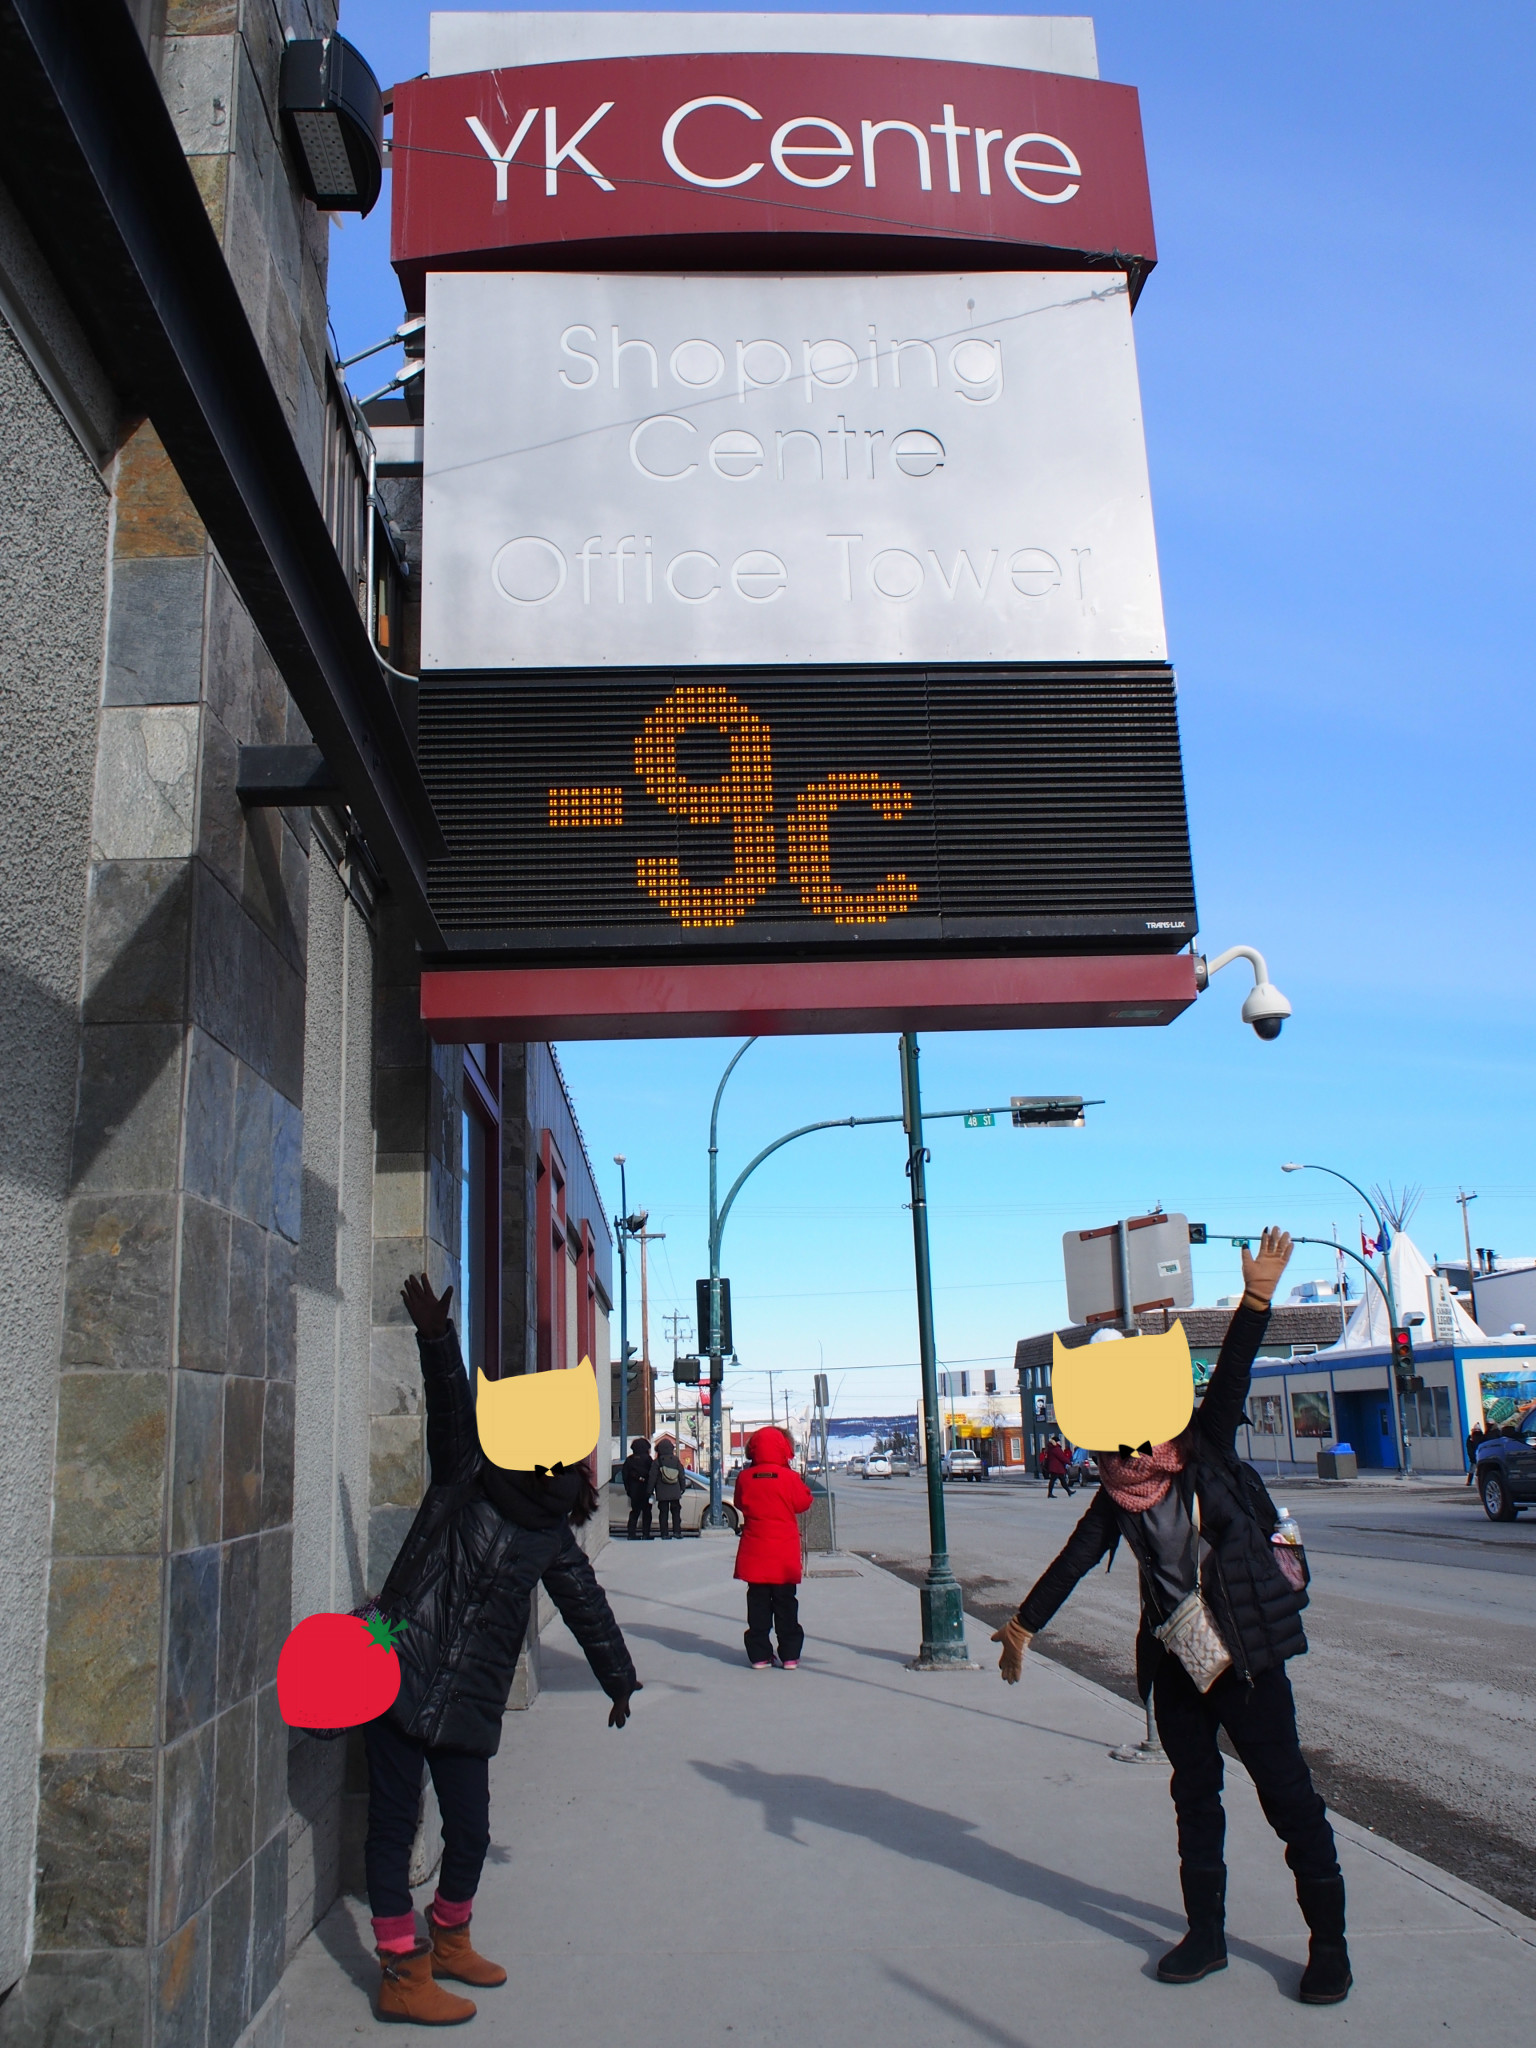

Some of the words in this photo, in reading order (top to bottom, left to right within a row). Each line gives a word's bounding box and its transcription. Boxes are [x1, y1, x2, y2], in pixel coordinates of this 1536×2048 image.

[465, 102, 616, 202] YK
[661, 95, 1083, 204] Centre
[558, 324, 1005, 406] Shopping
[629, 414, 946, 482] Centre
[490, 535, 788, 607] Office
[825, 533, 1092, 603] Tower
[968, 1116, 977, 1127] 48
[983, 1115, 992, 1126] ST
